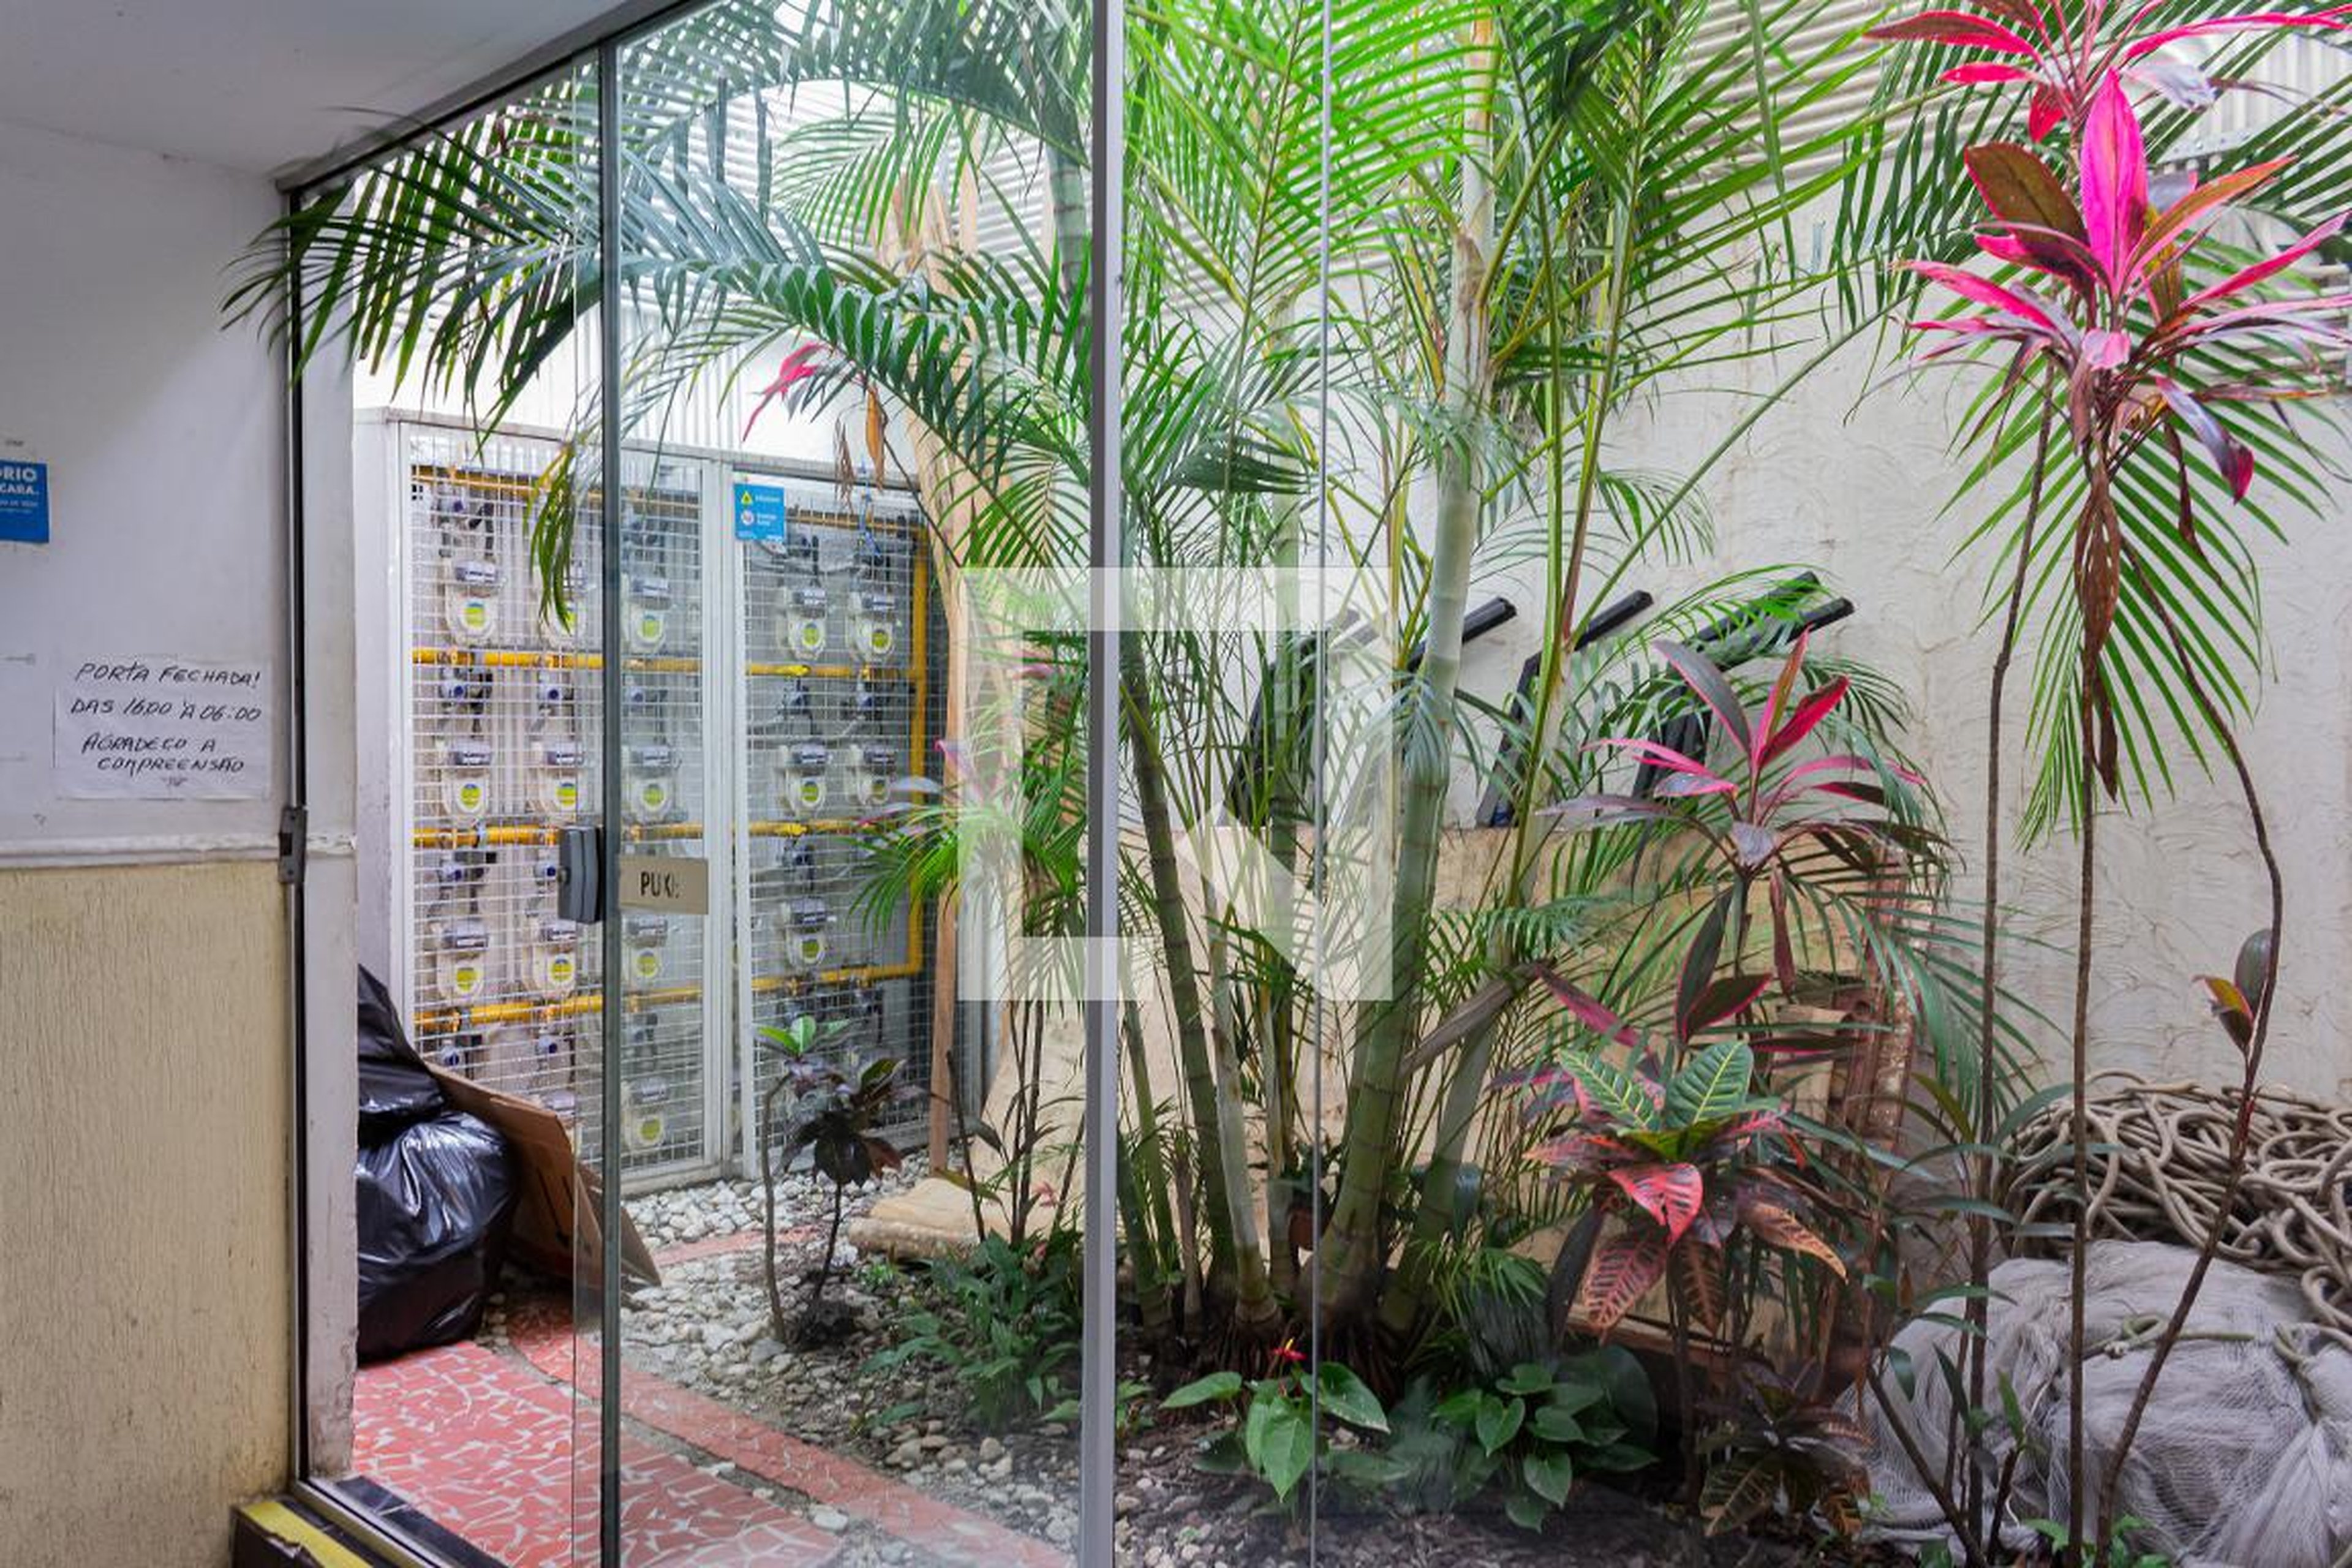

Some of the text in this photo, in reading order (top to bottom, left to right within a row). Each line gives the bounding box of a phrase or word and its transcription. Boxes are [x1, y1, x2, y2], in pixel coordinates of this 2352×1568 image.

[75, 662, 260, 688] PORTA FECHADA!
[71, 697, 115, 714] DAS
[200, 705, 262, 721] 06:00
[200, 739, 216, 752] A
